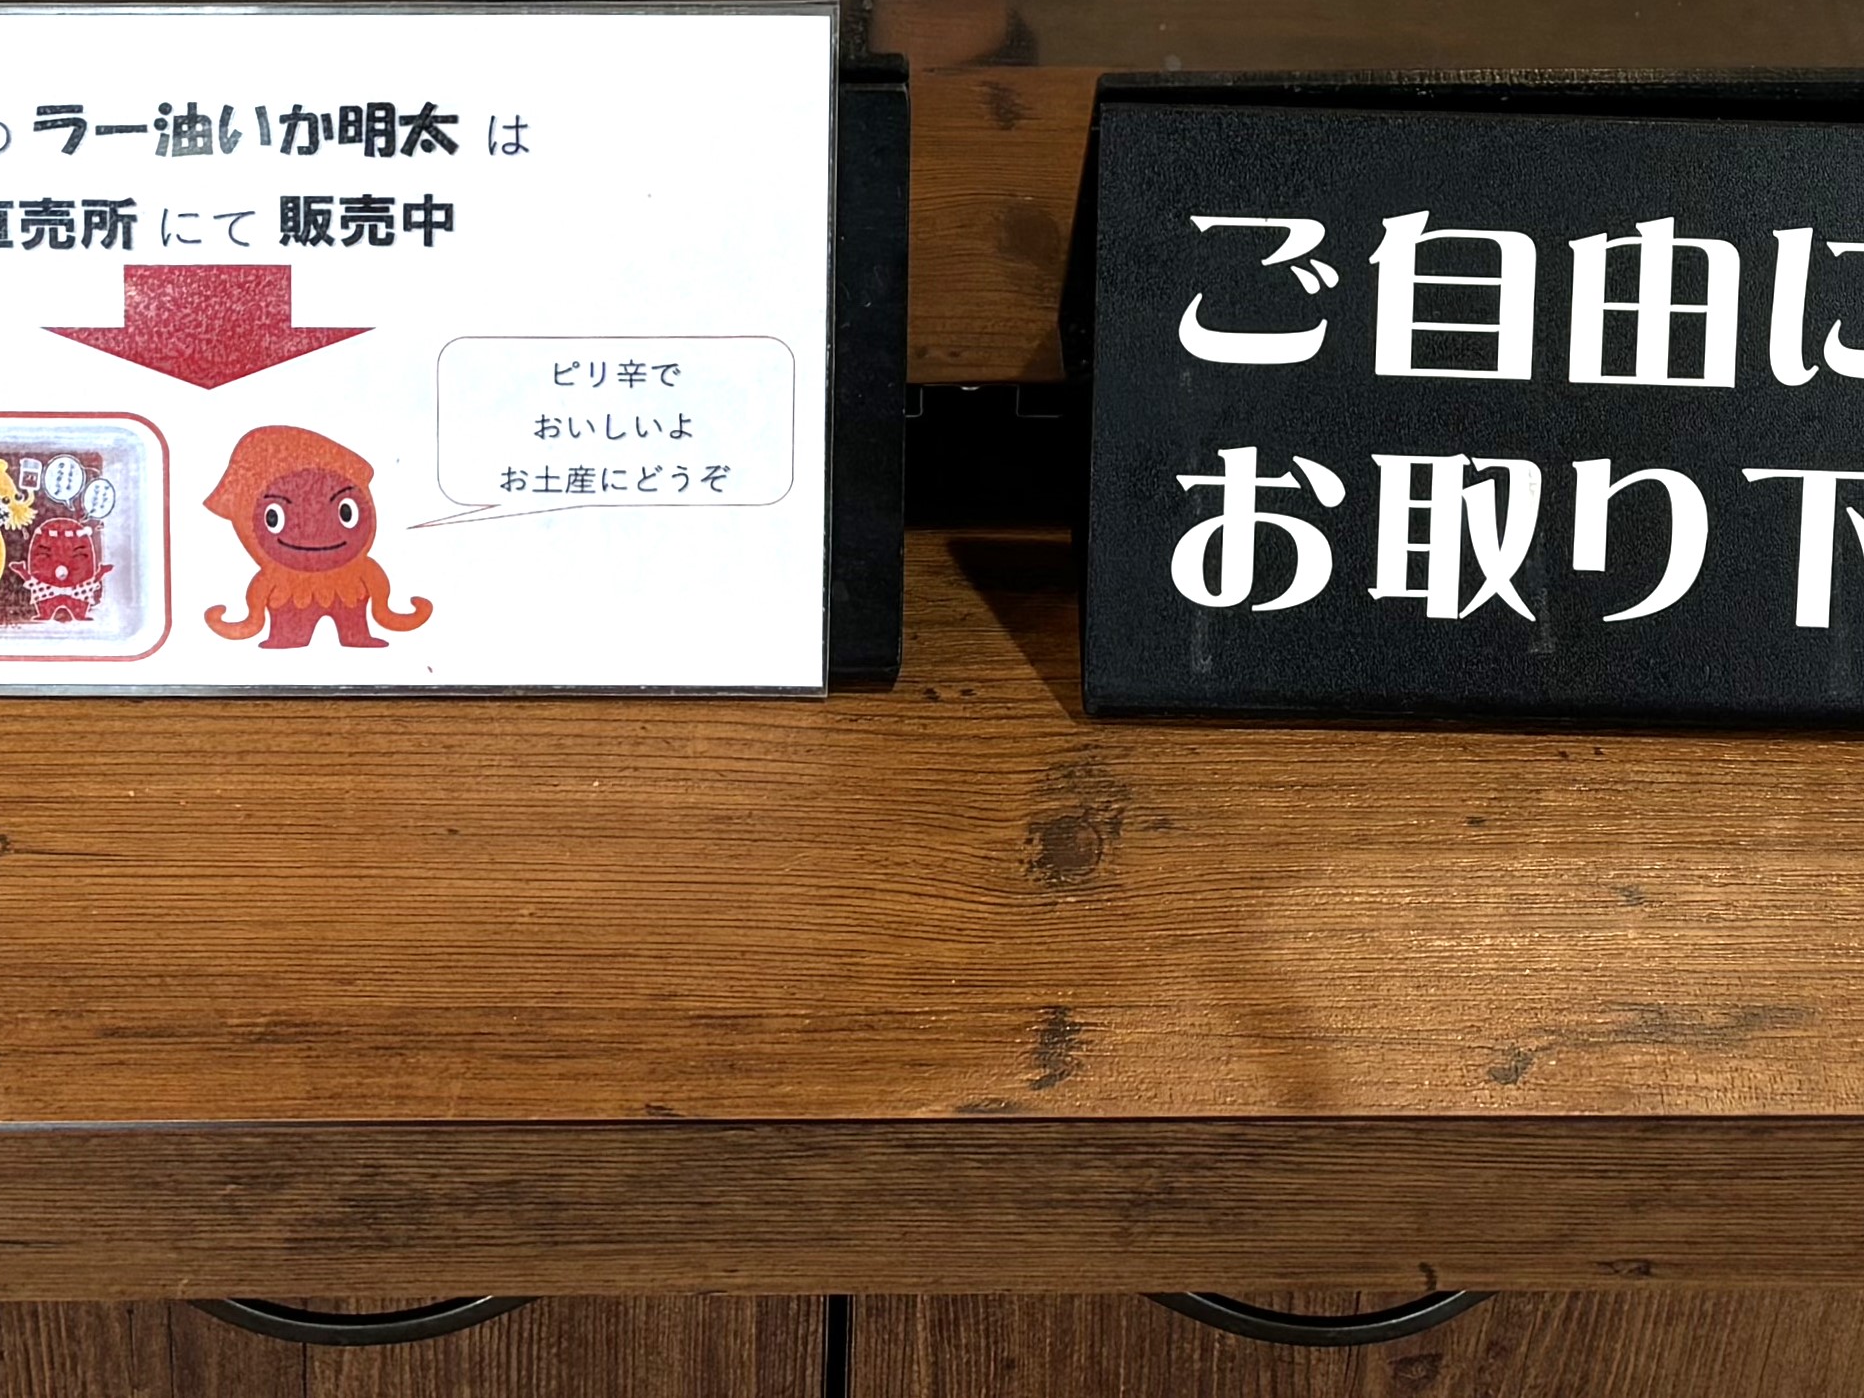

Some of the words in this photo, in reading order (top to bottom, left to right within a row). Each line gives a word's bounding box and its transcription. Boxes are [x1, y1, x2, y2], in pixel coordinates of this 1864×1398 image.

[34, 101, 460, 159] ラー油いか明太
[488, 115, 530, 157] は
[161, 209, 256, 249] にて
[279, 193, 456, 249] 販売中
[554, 359, 683, 389] ピリ辛で
[533, 413, 694, 441] おいしいよ
[500, 464, 732, 494] お土産にどうぞ
